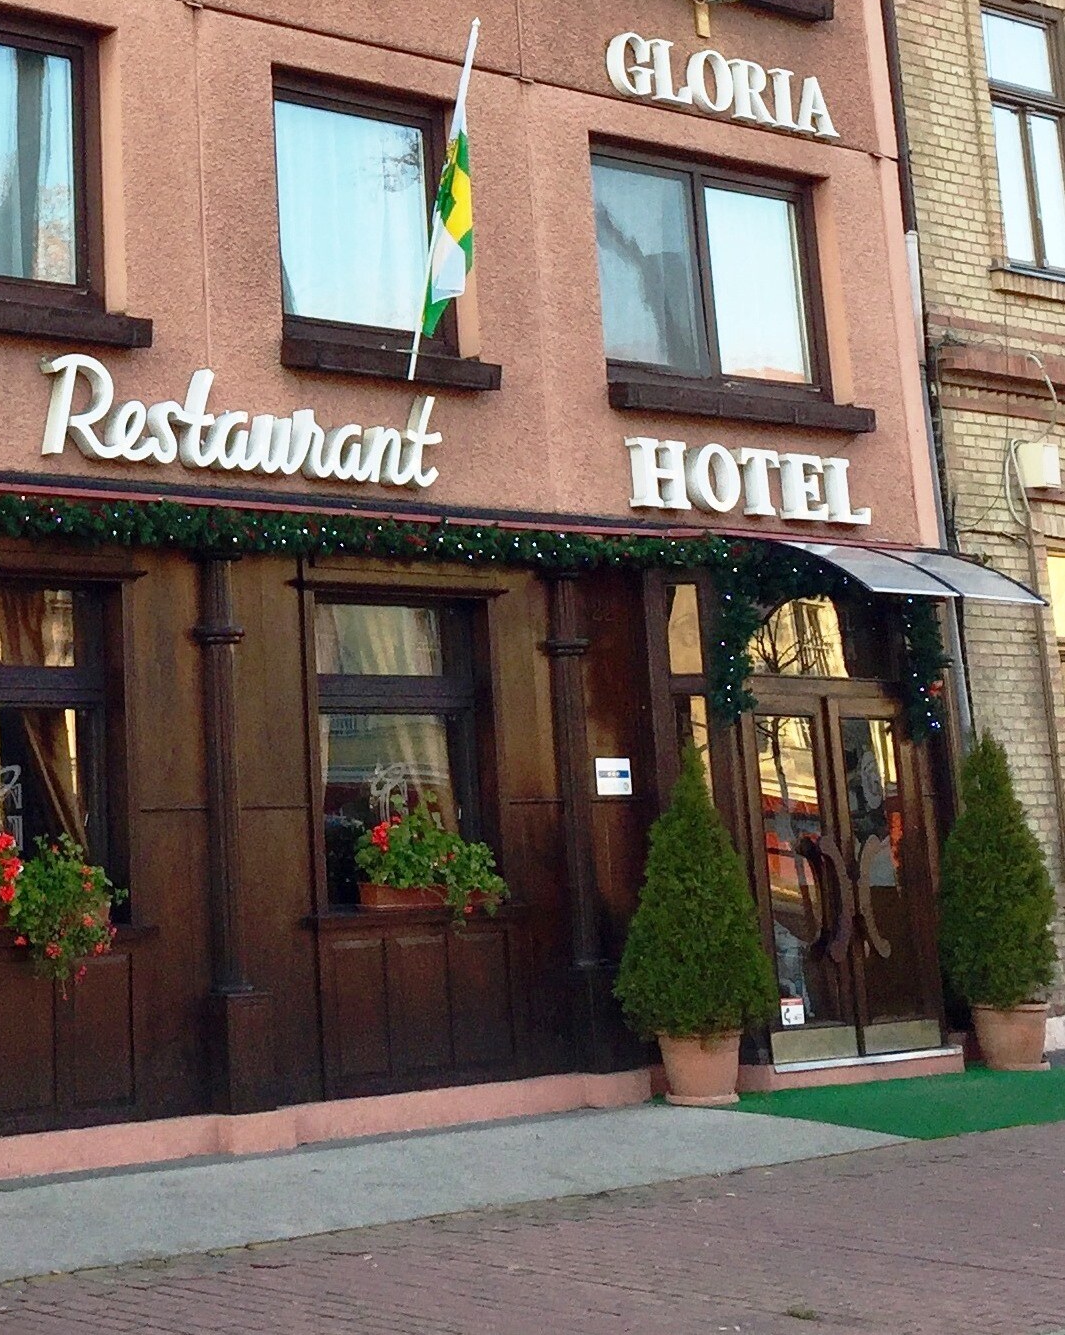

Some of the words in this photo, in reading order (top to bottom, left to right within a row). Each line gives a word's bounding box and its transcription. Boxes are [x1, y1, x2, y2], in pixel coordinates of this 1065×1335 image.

[605, 31, 841, 138] GLORIA
[39, 353, 443, 489] Restaurant
[625, 436, 872, 526] HOTEL
